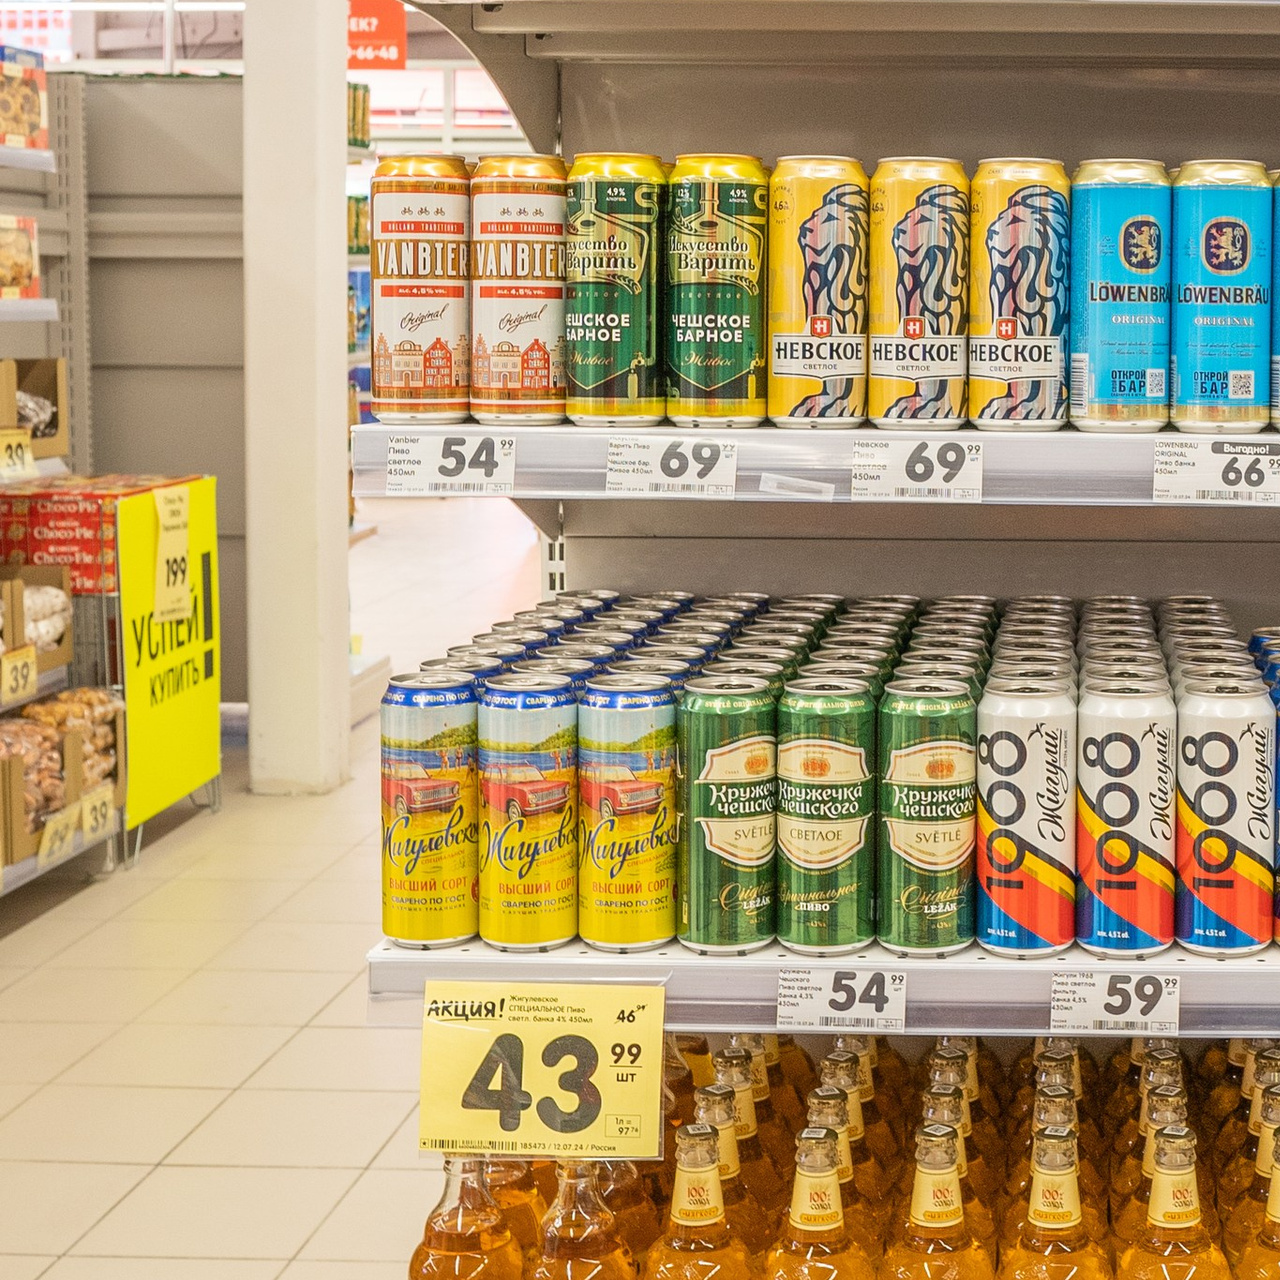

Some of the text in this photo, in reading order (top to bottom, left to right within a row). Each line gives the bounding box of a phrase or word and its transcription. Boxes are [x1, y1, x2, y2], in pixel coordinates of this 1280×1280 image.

[669, 236, 749, 253] Искусство
[377, 242, 468, 275] VANBIER
[678, 254, 756, 272] Варить
[1178, 283, 1268, 304] LÖWENBRÄU
[400, 306, 449, 331] Original
[672, 315, 751, 328] ЧЕШСКОЕ
[1194, 316, 1255, 326] ORIGINAL
[677, 328, 743, 343] БАРНОЕ
[776, 342, 863, 361] НЕВСКОЕ
[1194, 372, 1228, 382] ОТКРОЙ
[1200, 382, 1228, 394] БАР
[389, 436, 419, 445] Vanbier
[389, 447, 410, 456] Пиво
[1224, 443, 1270, 455] Выгодно!
[437, 437, 514, 477] 54 99
[659, 438, 735, 480] 69 99
[905, 441, 981, 483] 69 99
[388, 468, 415, 477] 450мл
[852, 472, 881, 481] 450мл
[1222, 457, 1265, 487] 66
[149, 658, 200, 707] КУПИТЬ
[779, 782, 862, 803] Кружечка
[781, 800, 859, 819] чешского
[790, 829, 843, 842] СВЕТЛОЕ
[915, 829, 961, 843] SVĚTLÉ
[390, 877, 467, 891] ВЫСШИЙ СОРТ
[391, 894, 466, 905] СВАРЕНО ПО ГОСТ
[799, 903, 829, 912] ПИВО
[509, 995, 558, 1003] Жигулевское
[828, 971, 904, 1012] 54 99
[1104, 974, 1178, 1016] 59 99
[427, 998, 505, 1020] АКЦИЯ!
[509, 1005, 565, 1014] СПЕЦИАЛЬНОЕ
[616, 1010, 636, 1023] 46
[461, 1033, 642, 1133] 43 99
